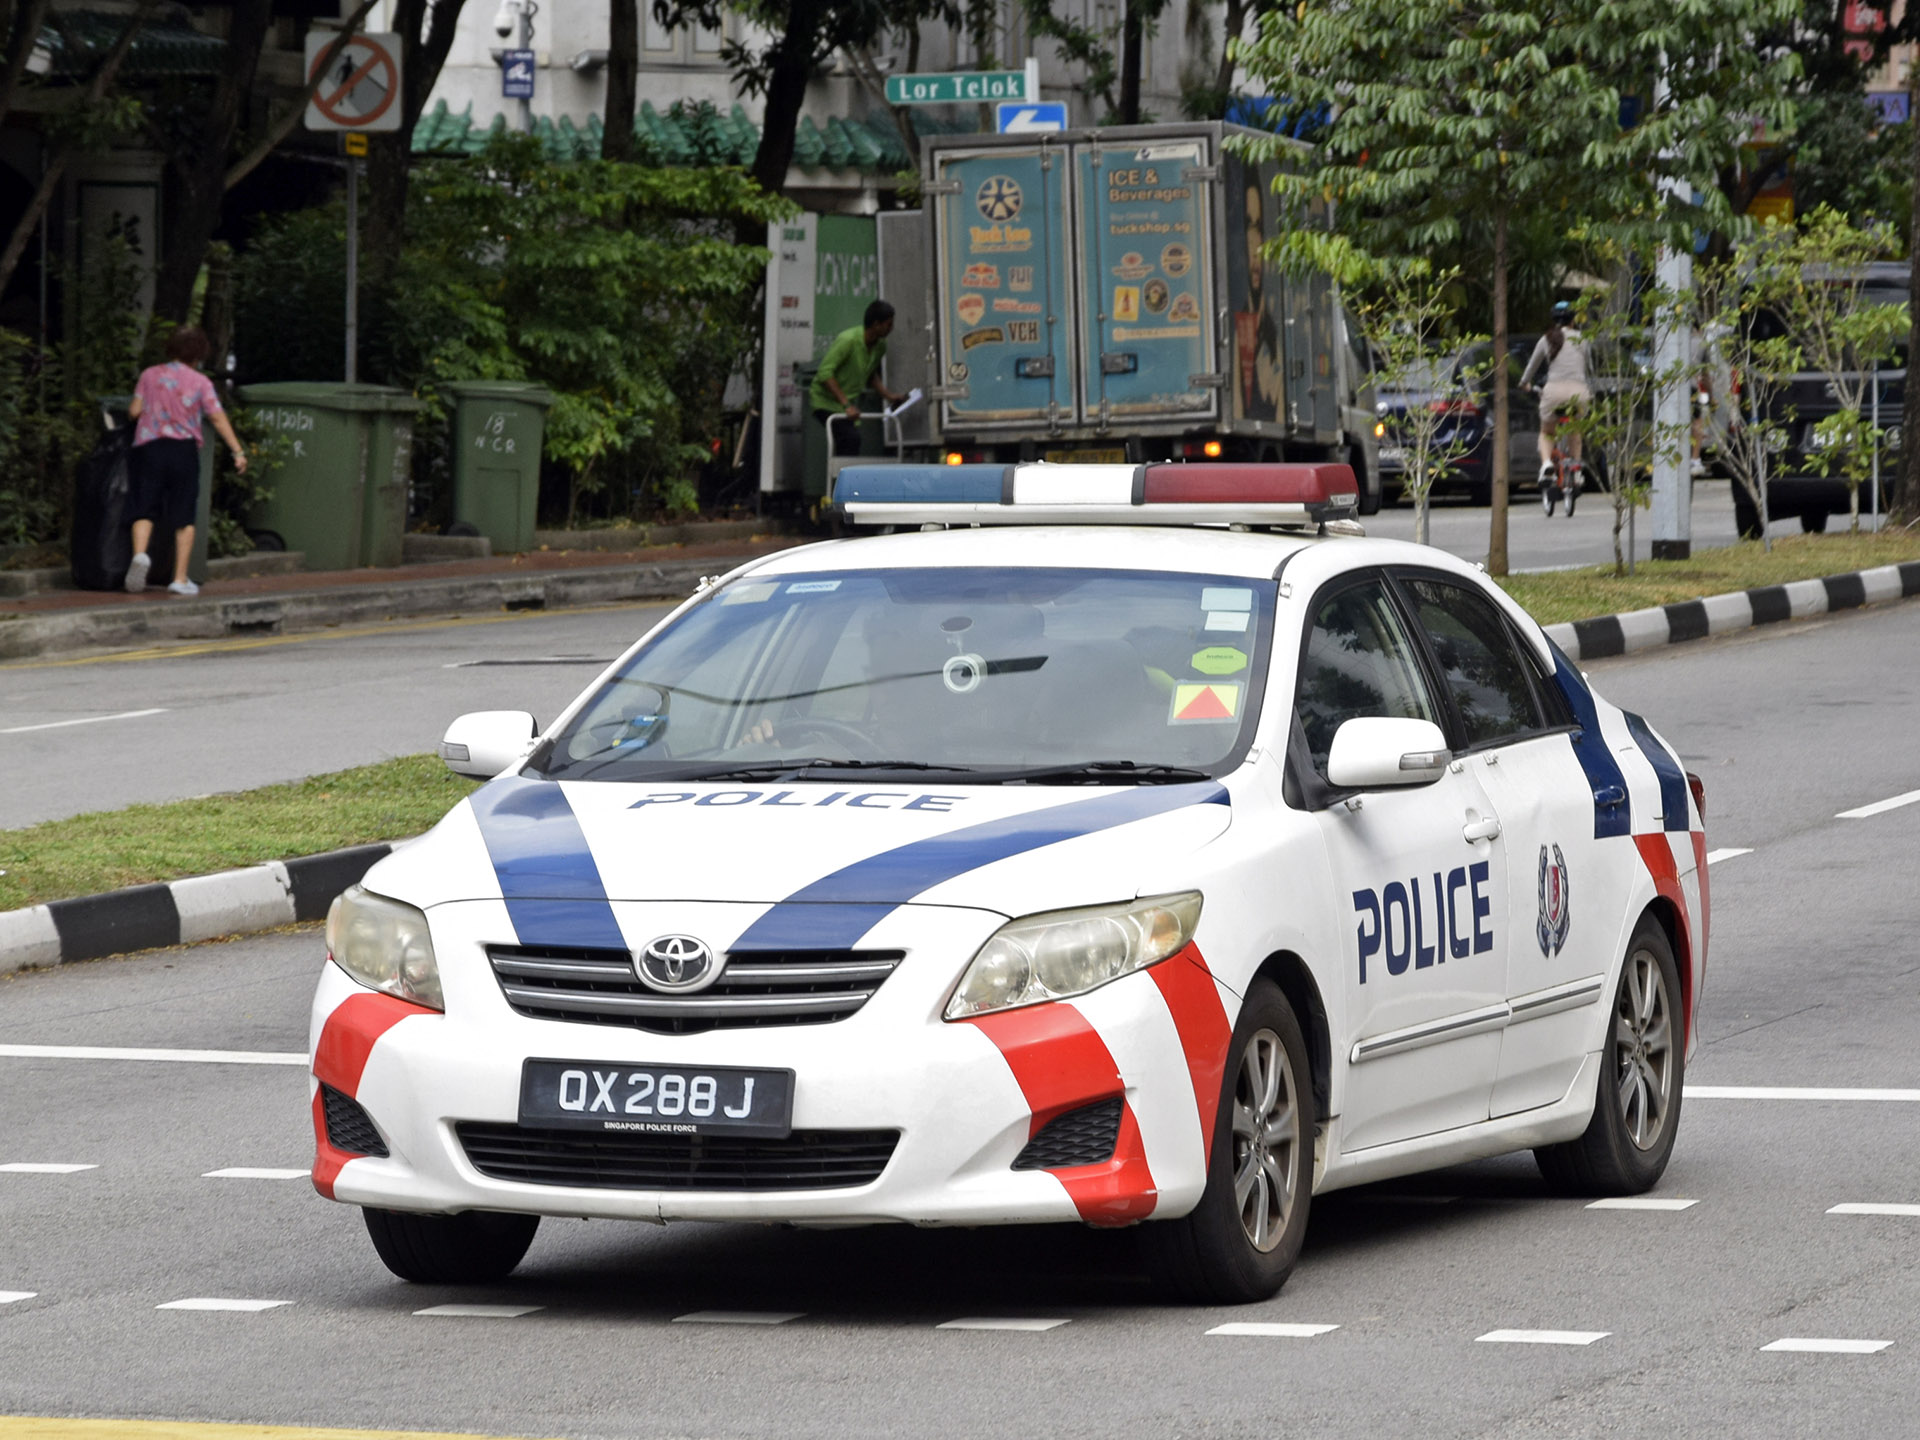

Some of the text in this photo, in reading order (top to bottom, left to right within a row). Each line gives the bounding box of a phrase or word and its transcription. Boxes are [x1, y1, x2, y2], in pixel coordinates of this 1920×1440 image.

[900, 75, 1020, 100] Lor Telok
[1108, 167, 1159, 187] ICE &
[1108, 188, 1190, 204] Beverages
[1110, 222, 1191, 236] tuckshop.sg
[1007, 321, 1039, 342] VCH
[625, 791, 972, 812] POLICE
[1352, 860, 1494, 985] POLICE
[603, 1121, 697, 1133] SINGAPORE POLICE FORCE
